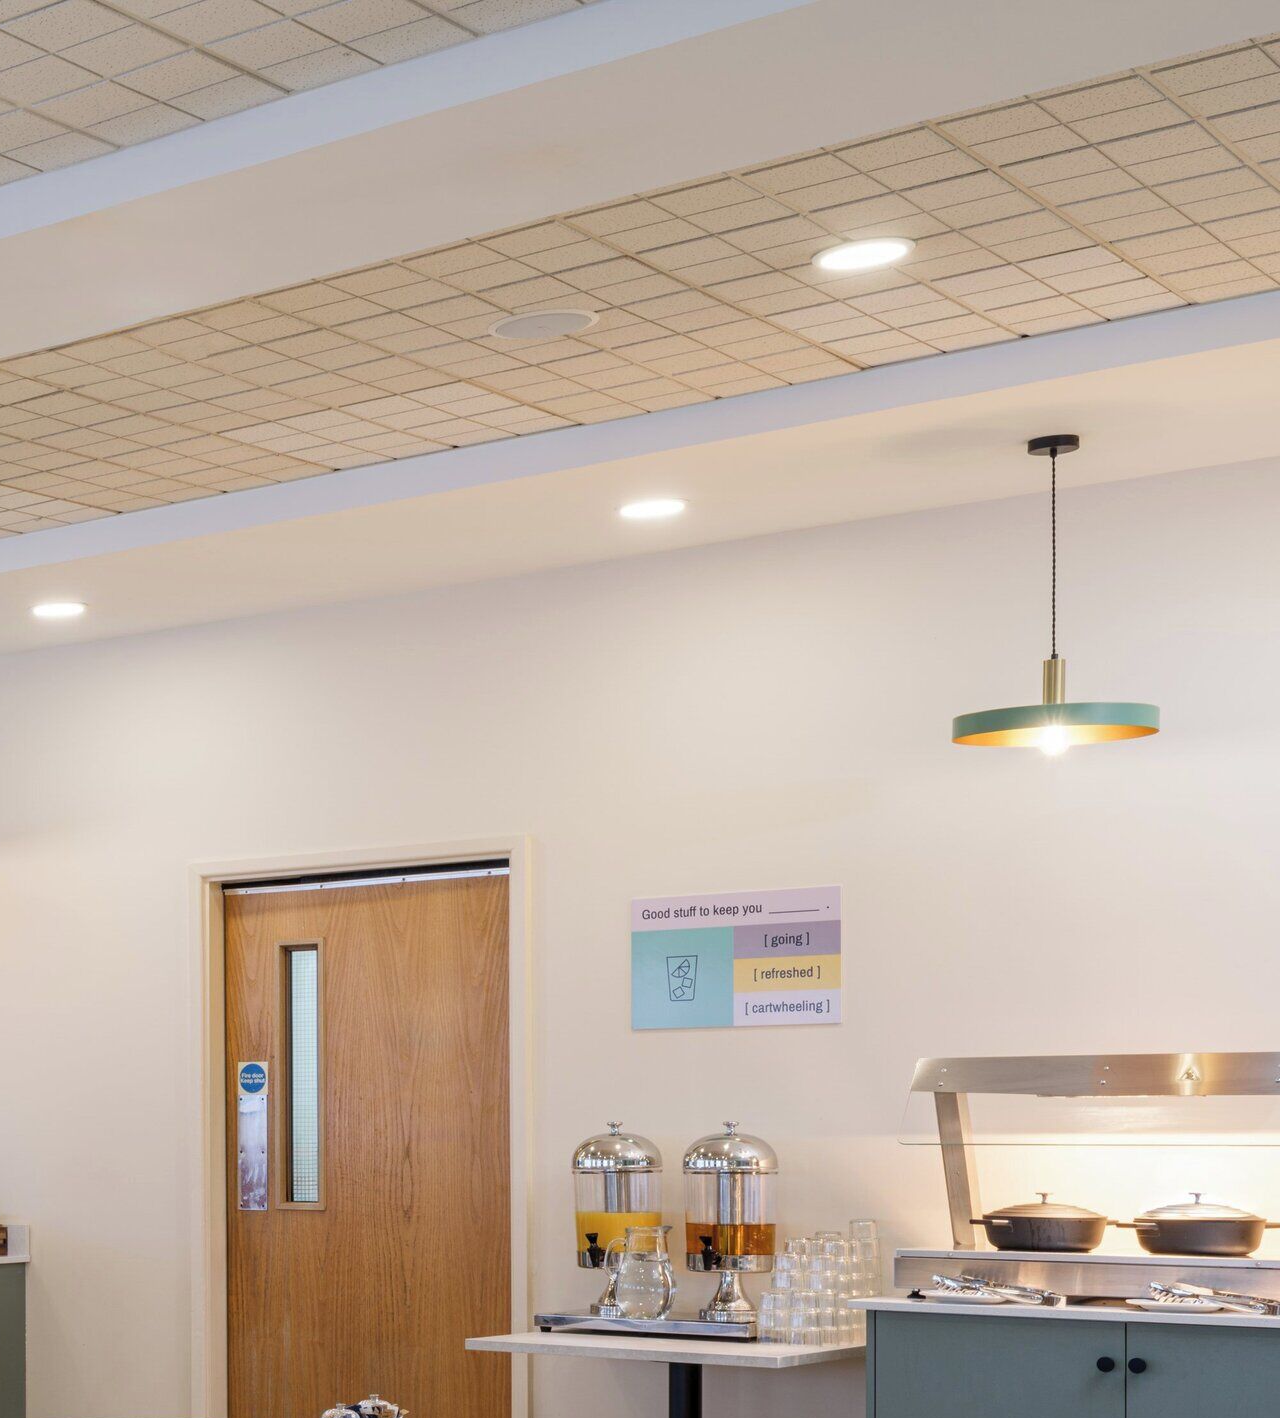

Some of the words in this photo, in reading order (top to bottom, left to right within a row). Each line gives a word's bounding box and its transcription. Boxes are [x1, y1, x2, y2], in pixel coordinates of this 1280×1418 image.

[642, 908, 670, 920] Good
[673, 905, 697, 918] stuff
[699, 906, 710, 917] to
[713, 904, 739, 917] keep
[742, 904, 762, 917] you
[771, 933, 803, 948] going
[761, 966, 814, 980] refreshed
[752, 1000, 824, 1014] cartwheeling
